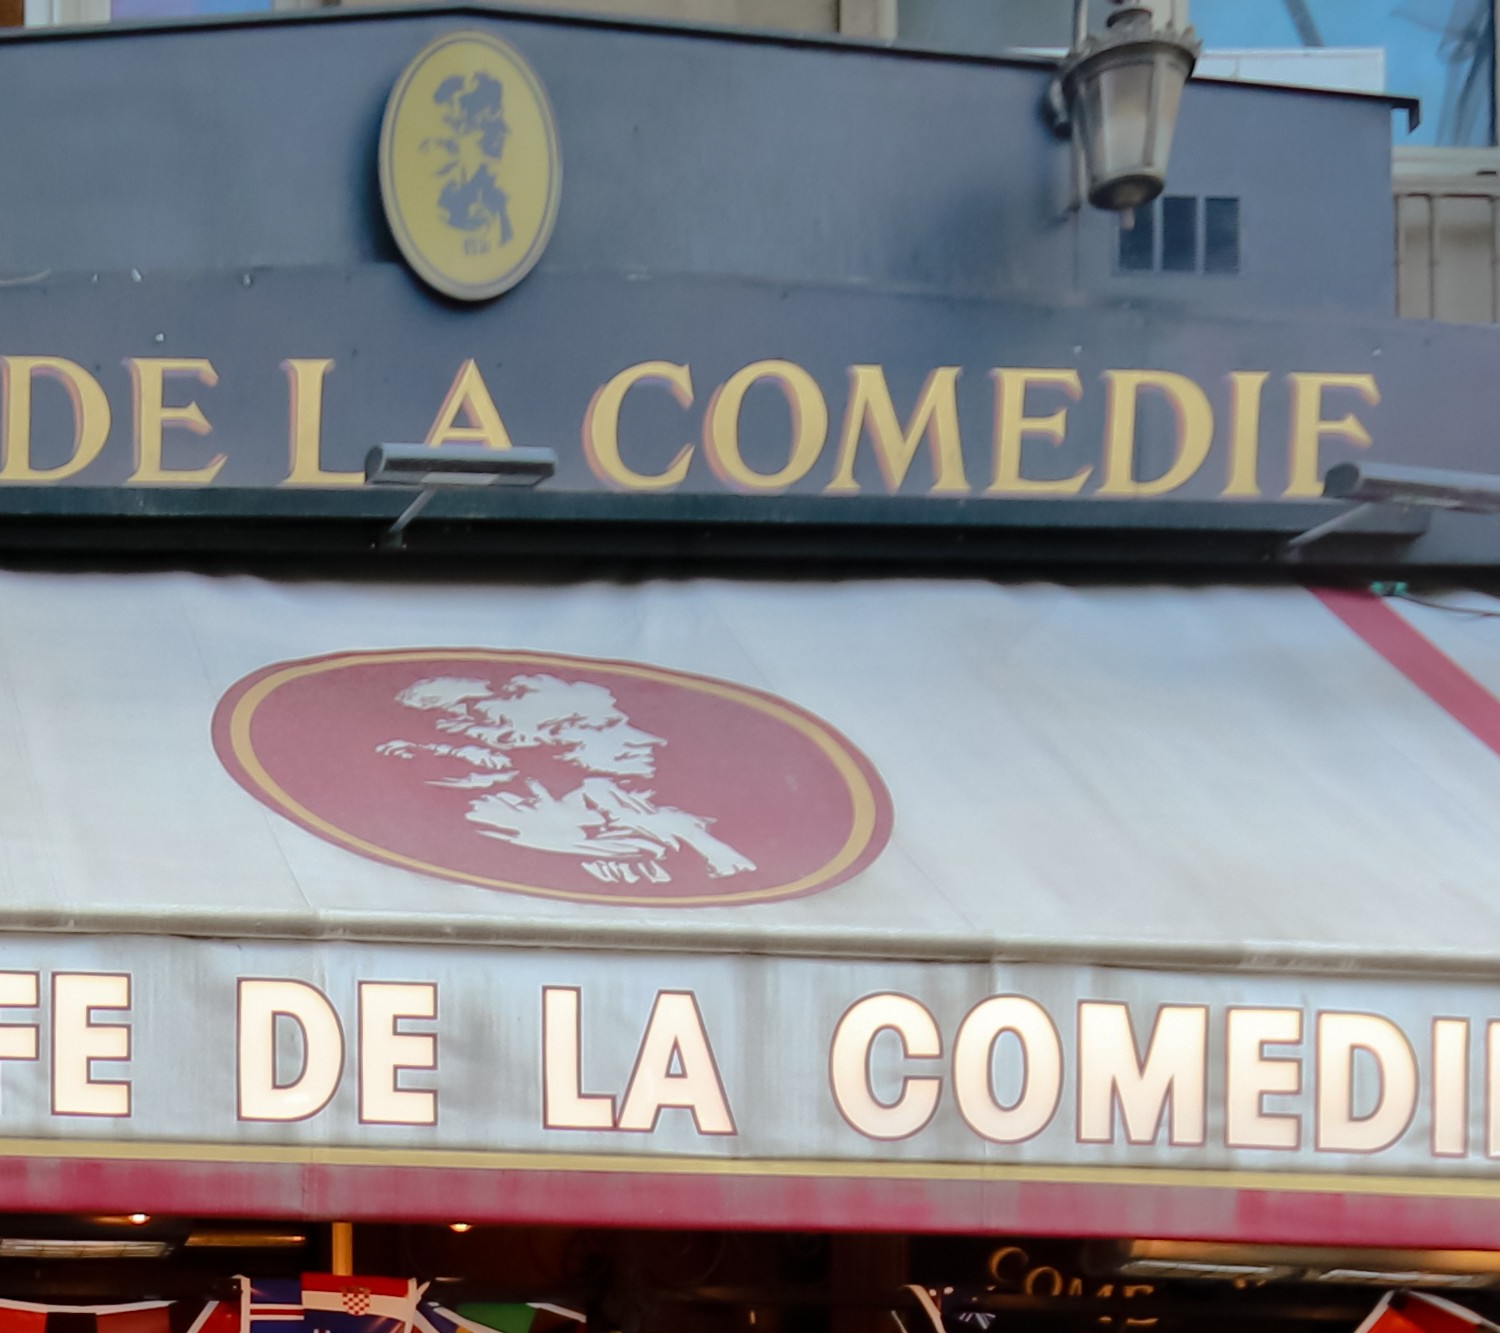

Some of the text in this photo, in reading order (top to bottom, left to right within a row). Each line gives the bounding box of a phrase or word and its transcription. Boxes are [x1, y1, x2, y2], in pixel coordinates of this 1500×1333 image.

[280, 357, 514, 487] LA
[581, 358, 1381, 495] COMEDIE
[236, 976, 439, 1126] DE
[541, 985, 737, 1137] LA
